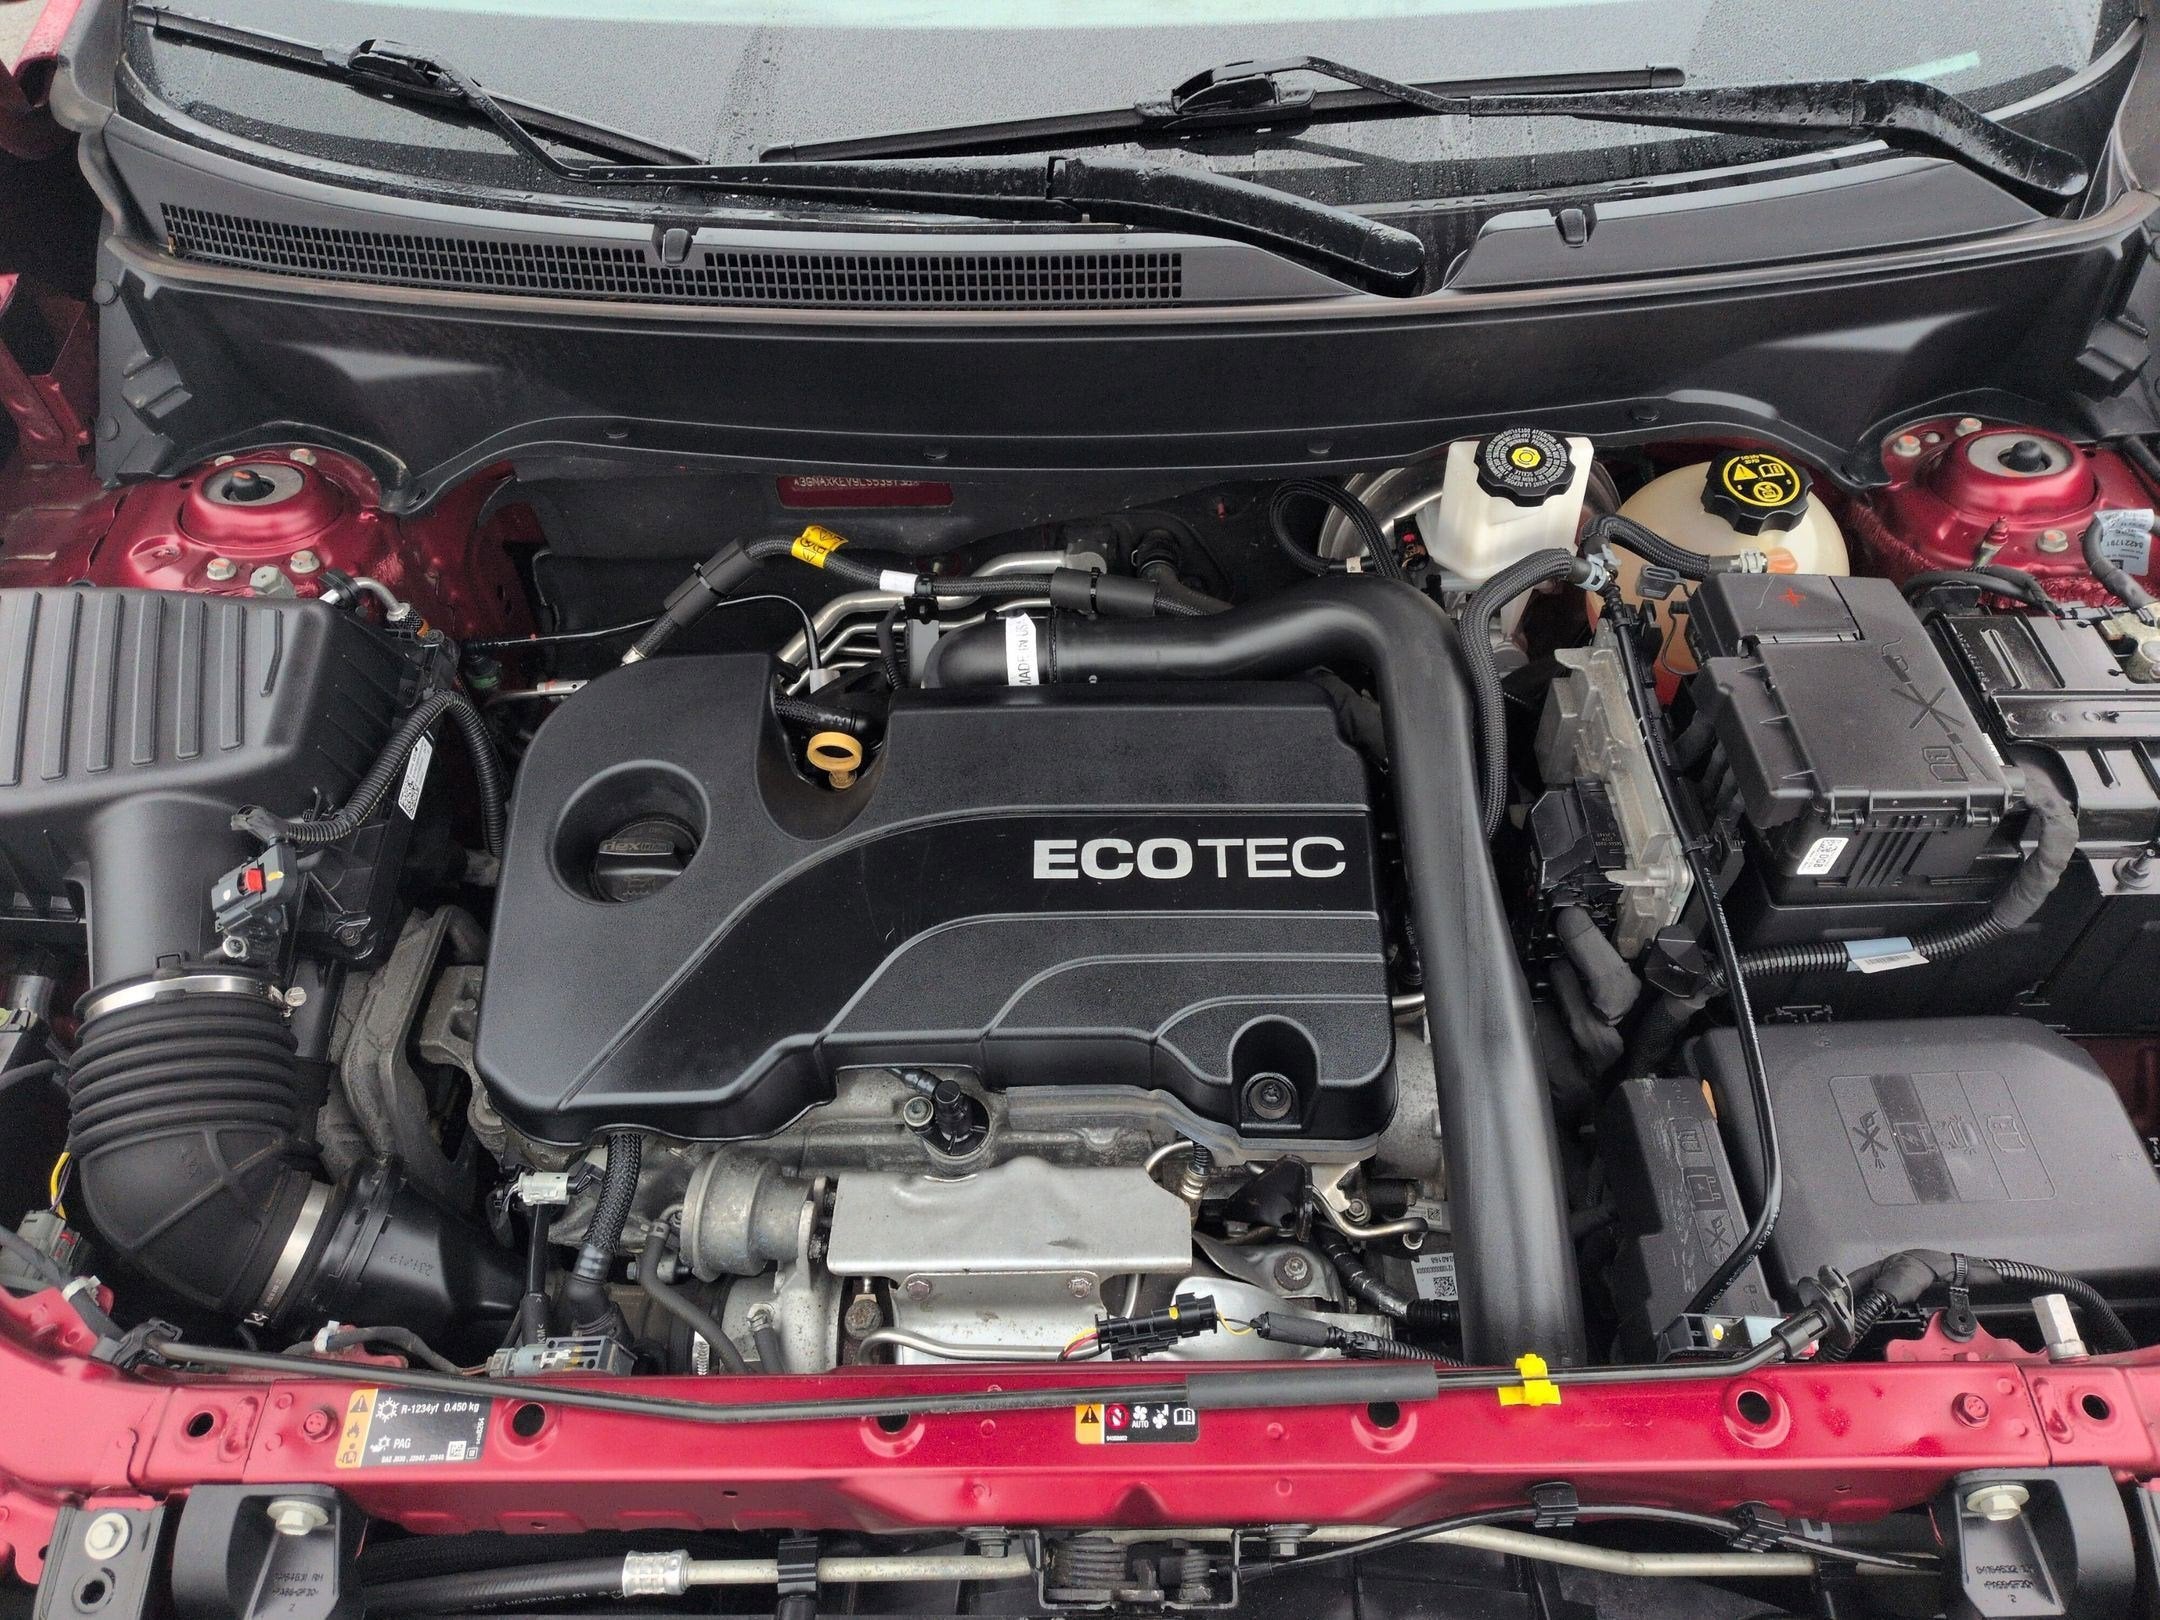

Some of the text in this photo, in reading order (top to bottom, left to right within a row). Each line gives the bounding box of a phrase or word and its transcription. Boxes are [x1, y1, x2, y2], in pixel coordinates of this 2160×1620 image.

[1033, 836, 1346, 879] ECOTEC
[401, 1401, 480, 1415] R-1234yf 0.450 kg
[1131, 1420, 1149, 1429] AUTO
[393, 1438, 412, 1449] PAG
